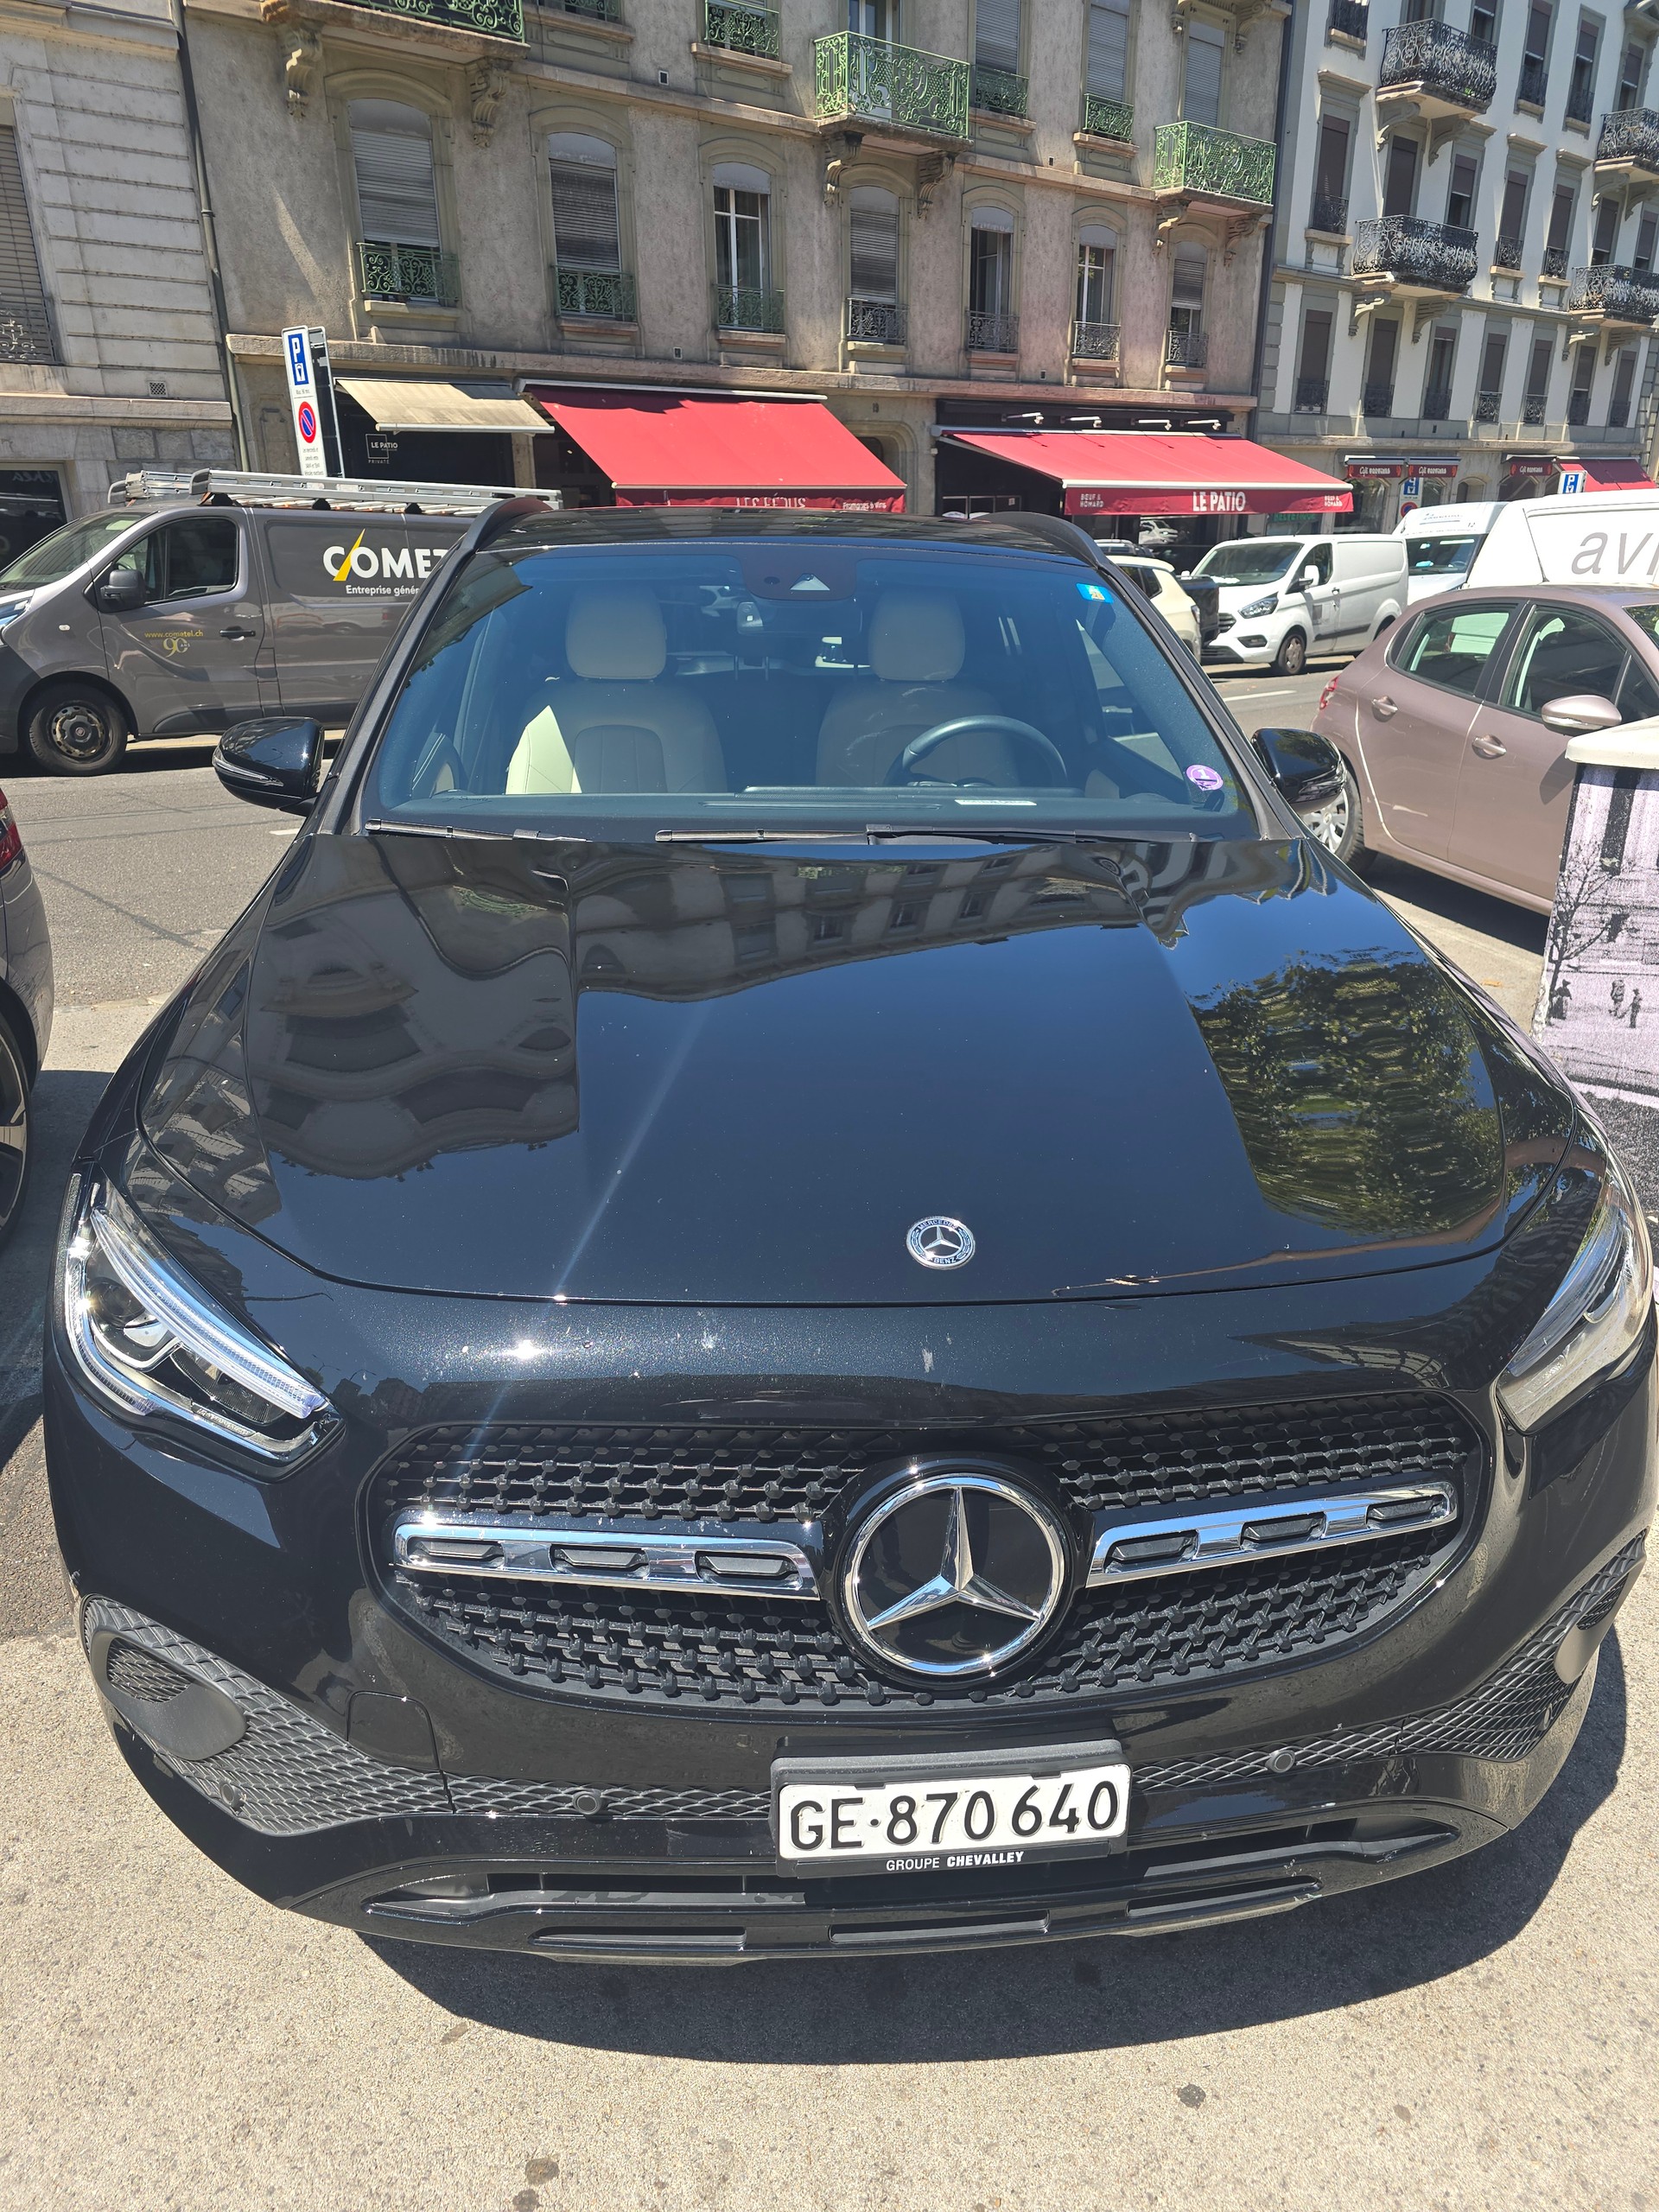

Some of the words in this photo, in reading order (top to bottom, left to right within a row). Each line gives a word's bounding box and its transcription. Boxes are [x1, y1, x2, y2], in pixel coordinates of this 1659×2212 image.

[291, 337, 301, 363] P
[1192, 491, 1207, 512] LE
[1210, 491, 1246, 512] PATIO
[346, 584, 391, 596] Entreprise
[886, 1857, 940, 1872] GROUPE
[946, 1851, 1025, 1868] CHEVALLEY
